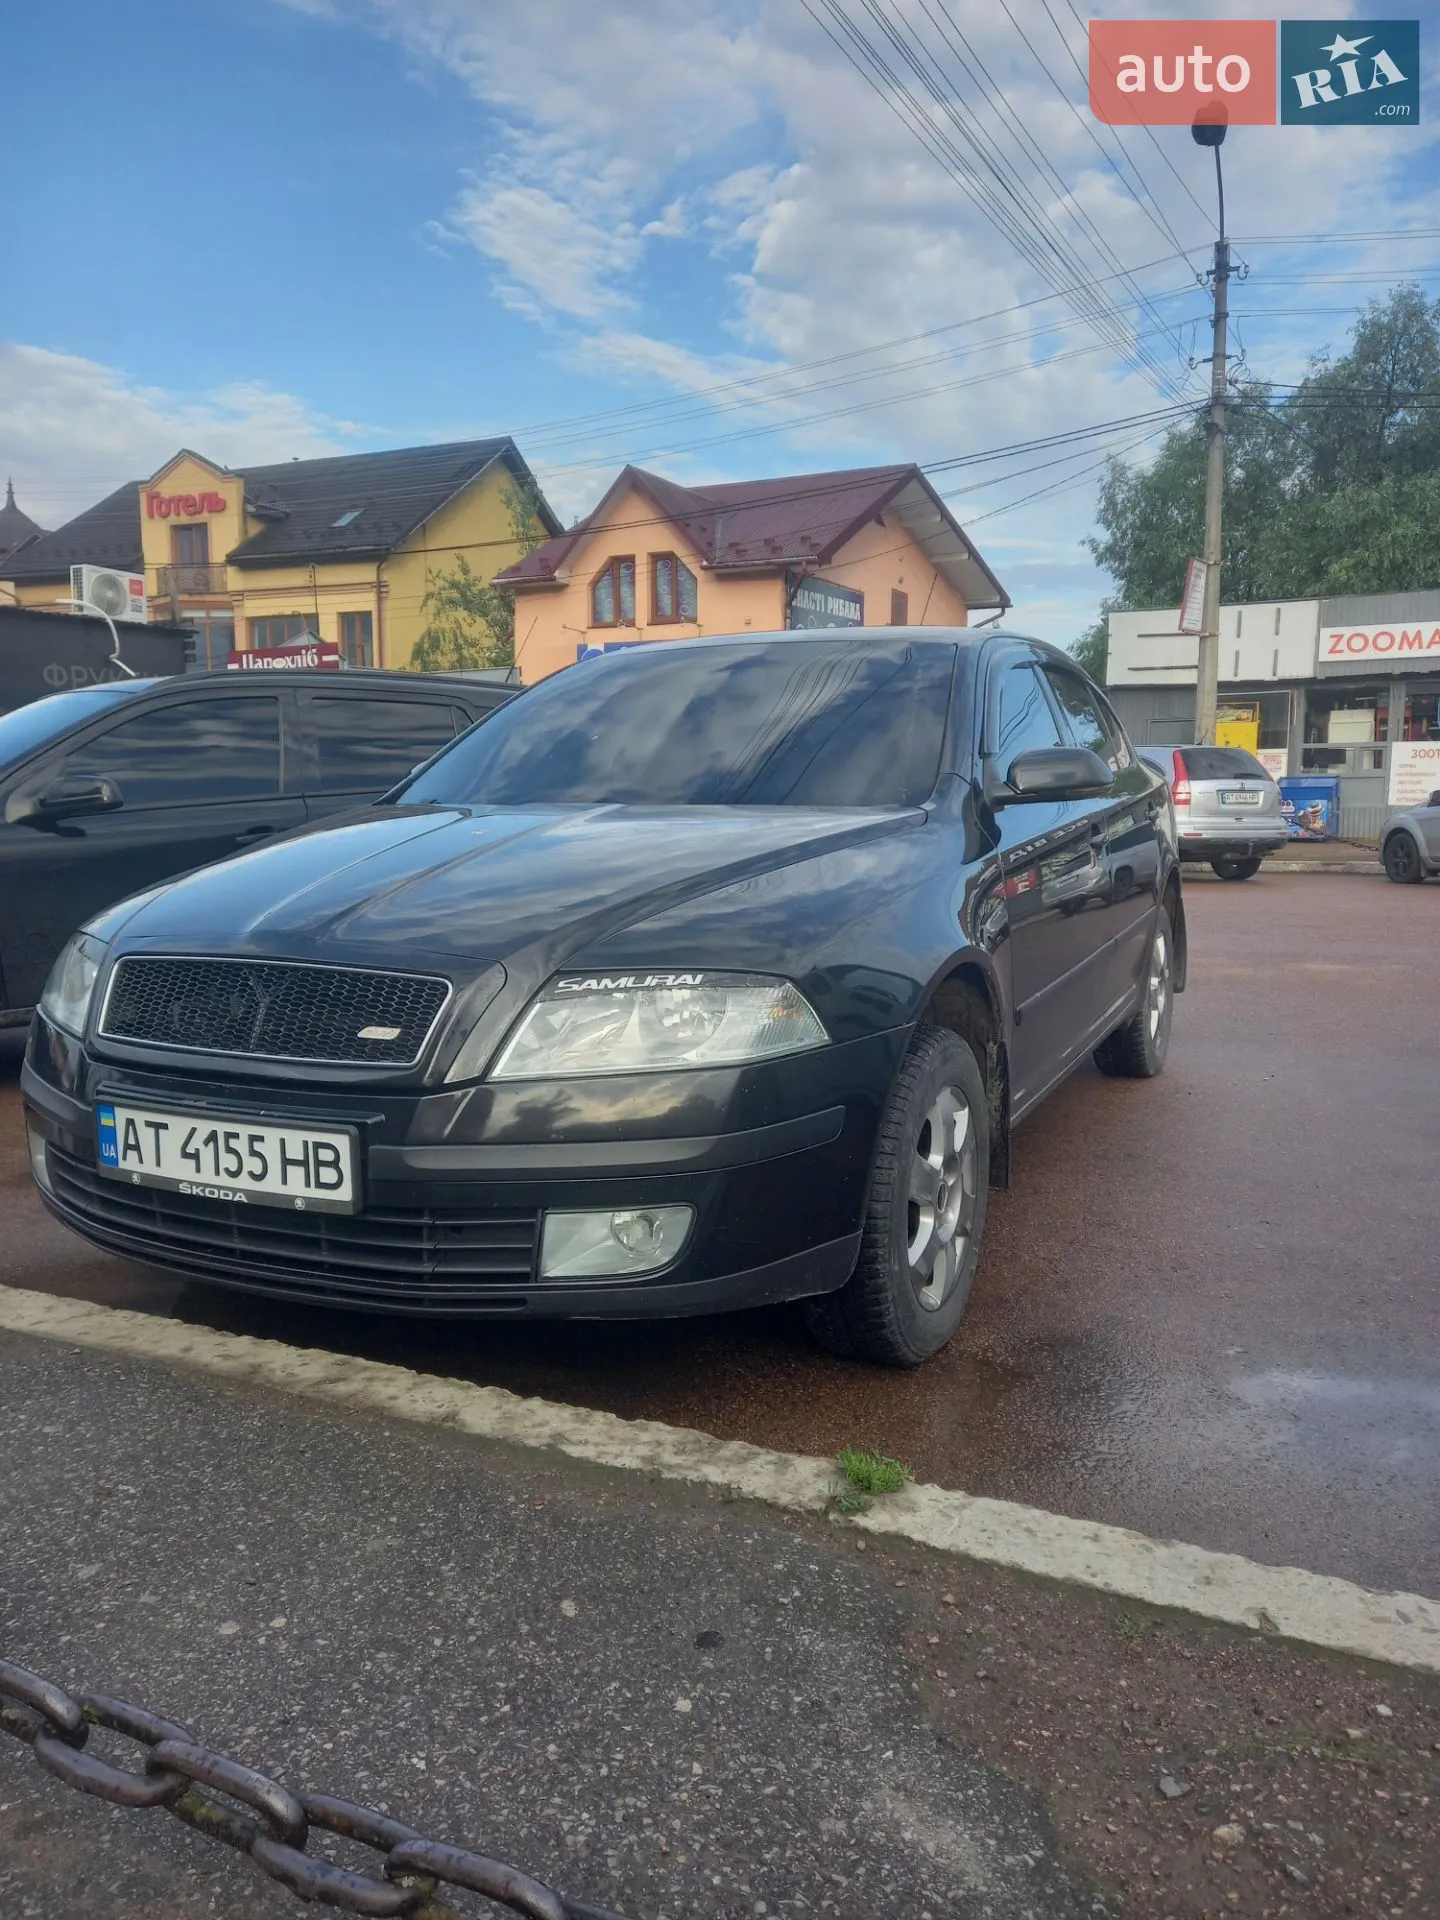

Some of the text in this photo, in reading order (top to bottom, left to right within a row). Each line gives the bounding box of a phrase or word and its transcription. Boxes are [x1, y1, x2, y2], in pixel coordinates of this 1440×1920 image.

[146, 491, 226, 520] Готель
[1328, 628, 1440, 655] ZOOMA
[554, 974, 704, 993] SAMURAI
[101, 1142, 118, 1160] UA
[122, 1117, 345, 1190] AT 4155 HB
[178, 1181, 249, 1204] ŠKODA
